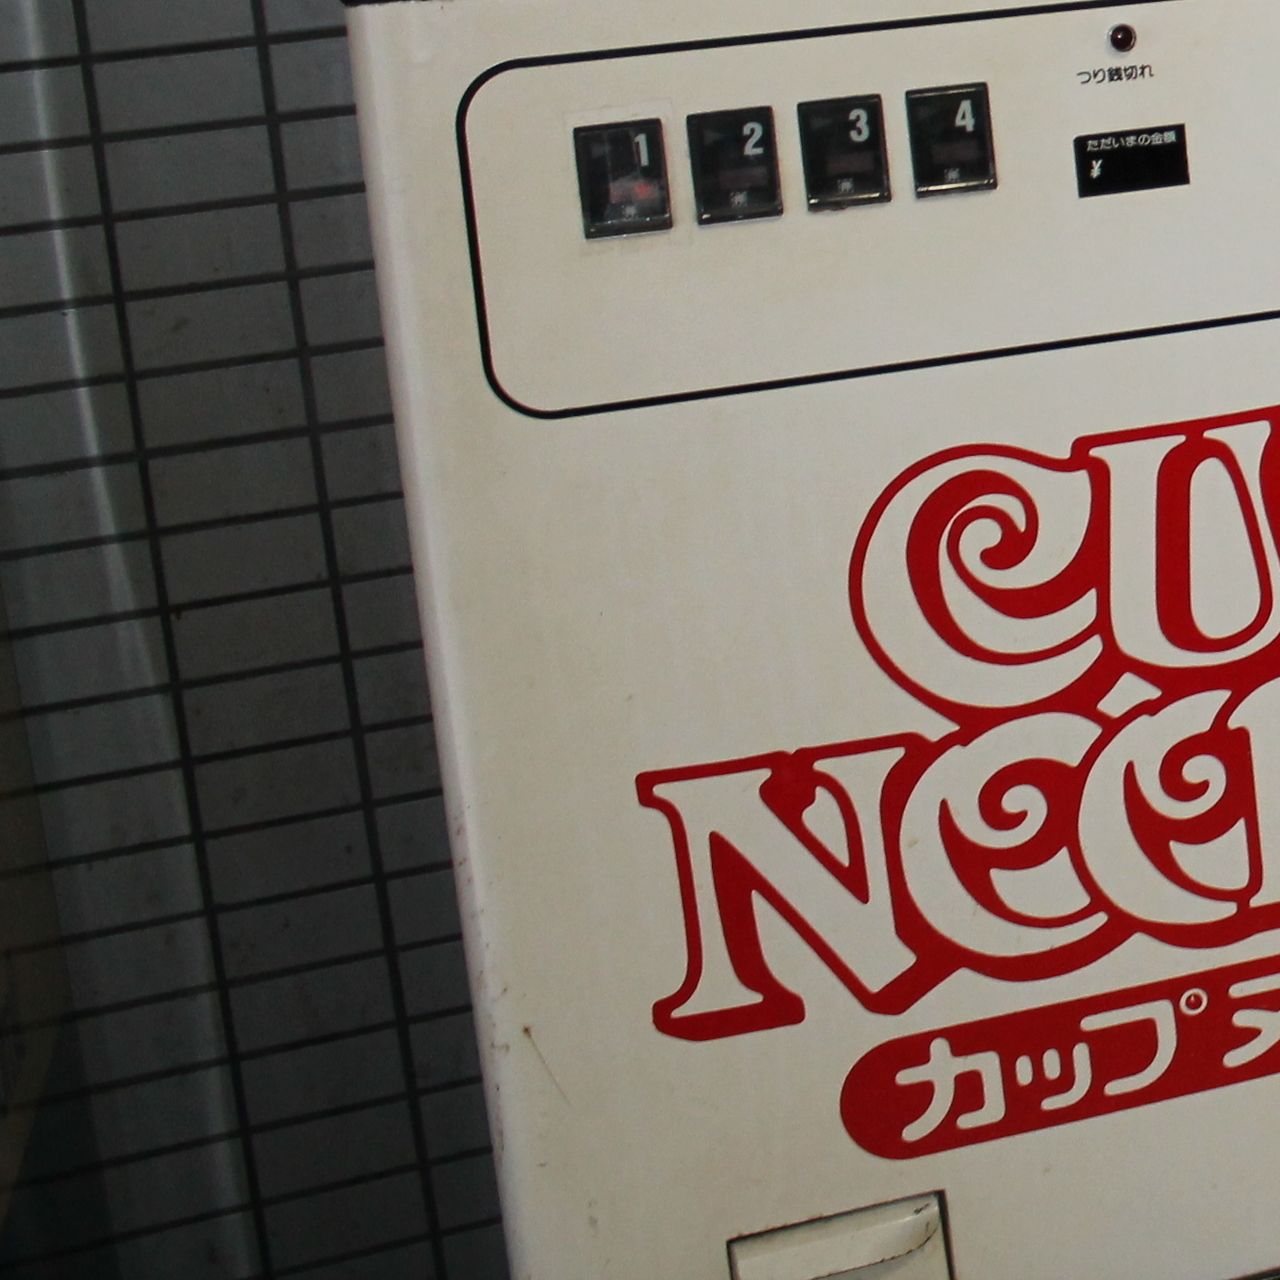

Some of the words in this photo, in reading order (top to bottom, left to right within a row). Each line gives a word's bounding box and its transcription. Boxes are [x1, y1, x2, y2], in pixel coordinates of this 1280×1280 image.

[1076, 62, 1156, 86] つり銭切れ
[848, 108, 870, 143] 3
[954, 99, 974, 132] 4
[633, 133, 649, 168] 1
[742, 121, 765, 156] 2
[1086, 131, 1177, 152] ただいまの金額
